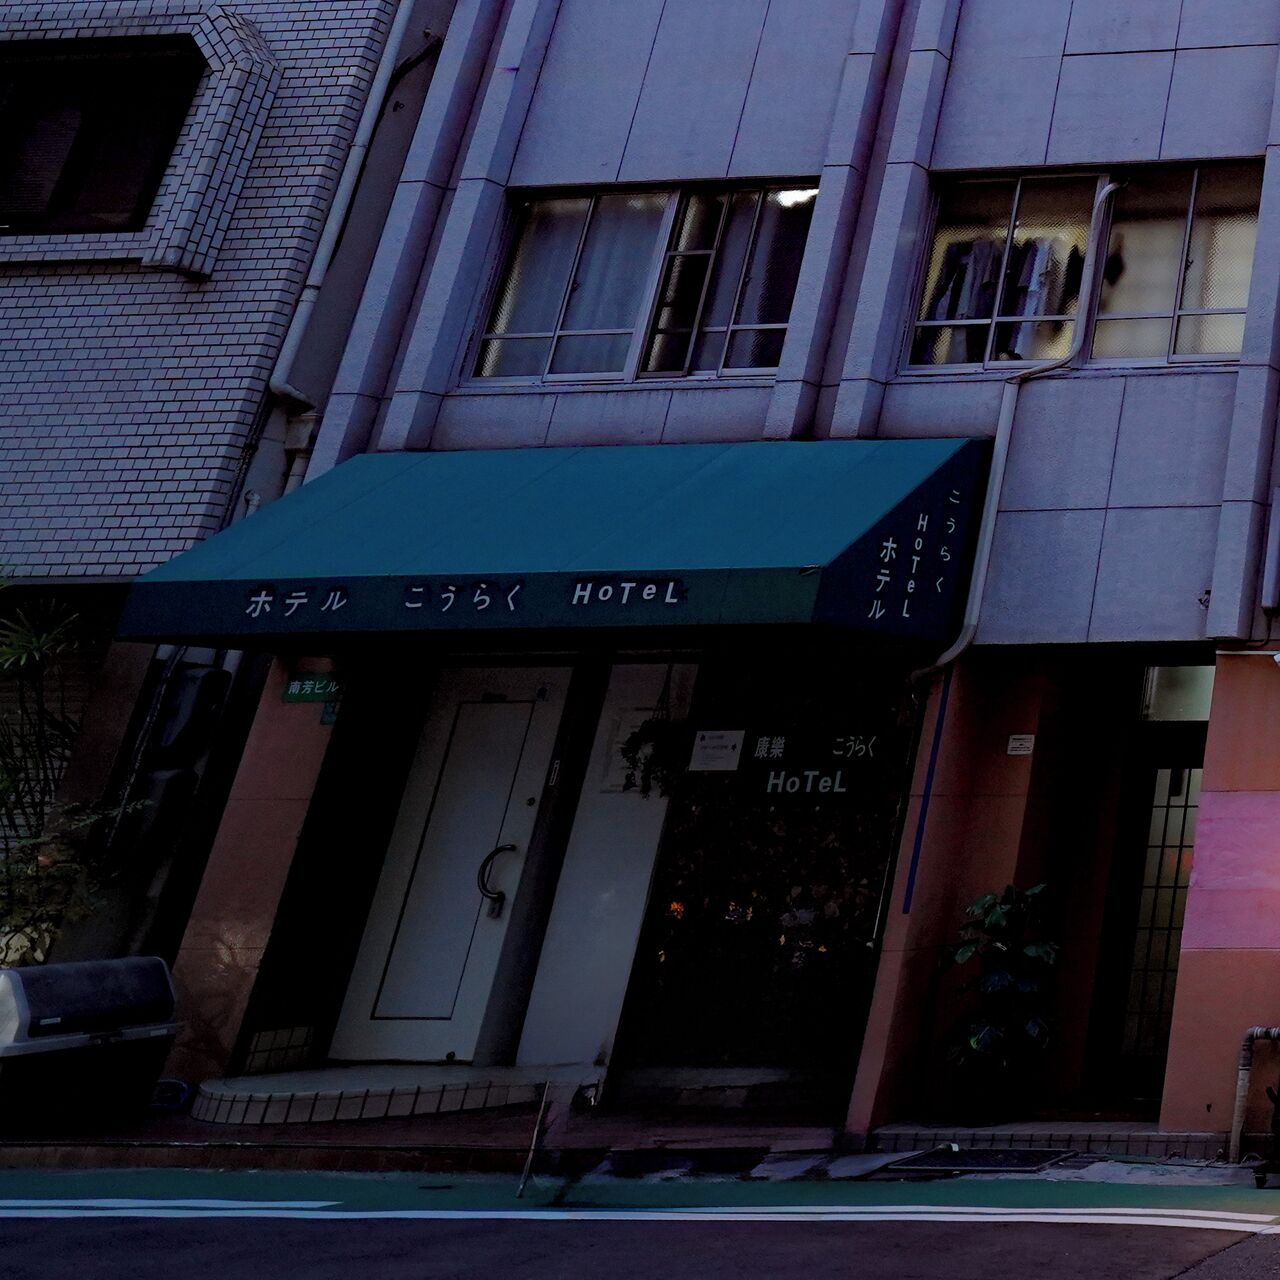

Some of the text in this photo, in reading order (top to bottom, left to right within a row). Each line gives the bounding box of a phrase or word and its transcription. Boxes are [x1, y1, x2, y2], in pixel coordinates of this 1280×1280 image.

[936, 489, 960, 593] こうらく
[245, 590, 348, 618] ホテル
[404, 584, 522, 612] こうらく
[868, 537, 897, 619] ホテル
[832, 735, 877, 758] こうらく
